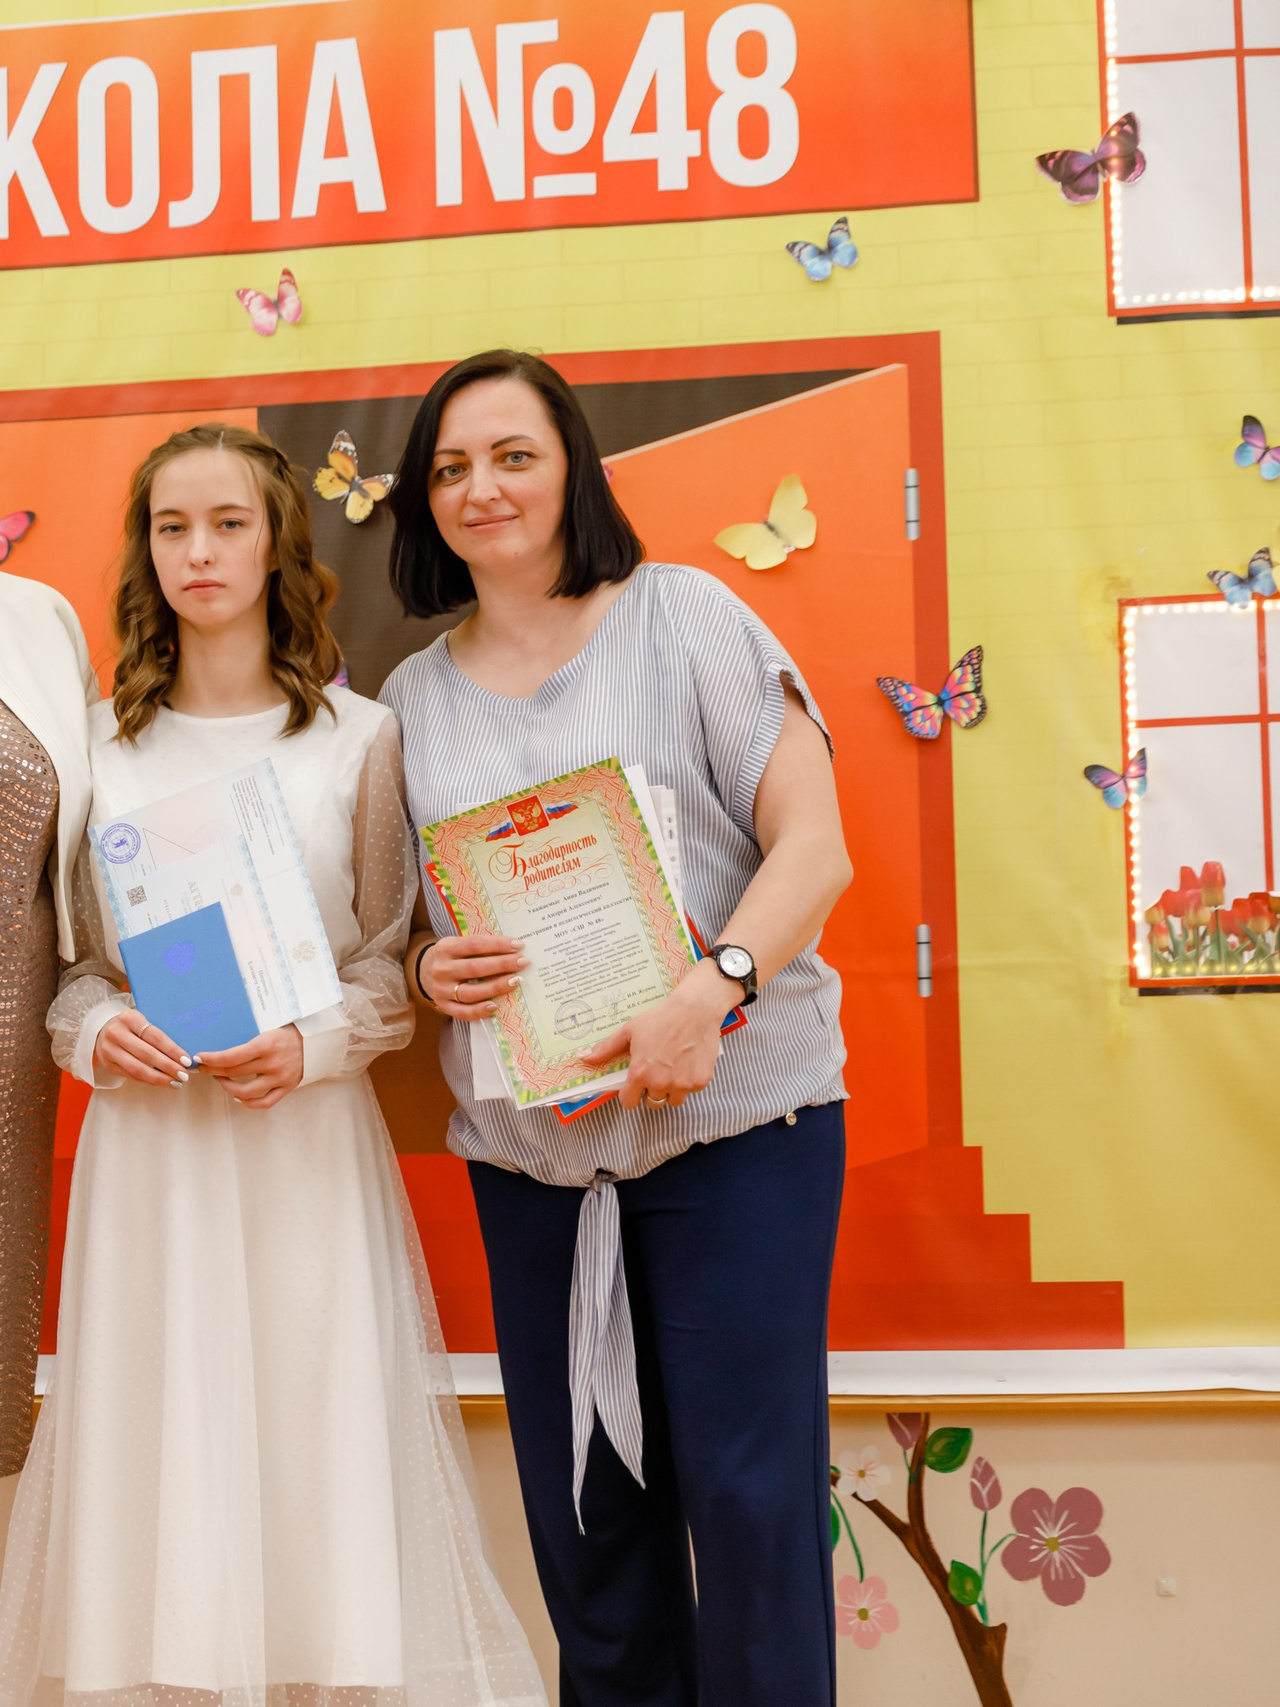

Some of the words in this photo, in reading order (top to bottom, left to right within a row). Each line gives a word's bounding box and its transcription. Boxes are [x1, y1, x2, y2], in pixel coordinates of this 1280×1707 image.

[434, 3, 800, 207] №48
[488, 834, 597, 882] Благодарность
[524, 857, 581, 890] родителям
[527, 900, 560, 914] Уважаемые
[563, 893, 577, 901] Анна
[547, 908, 567, 919] Андрей
